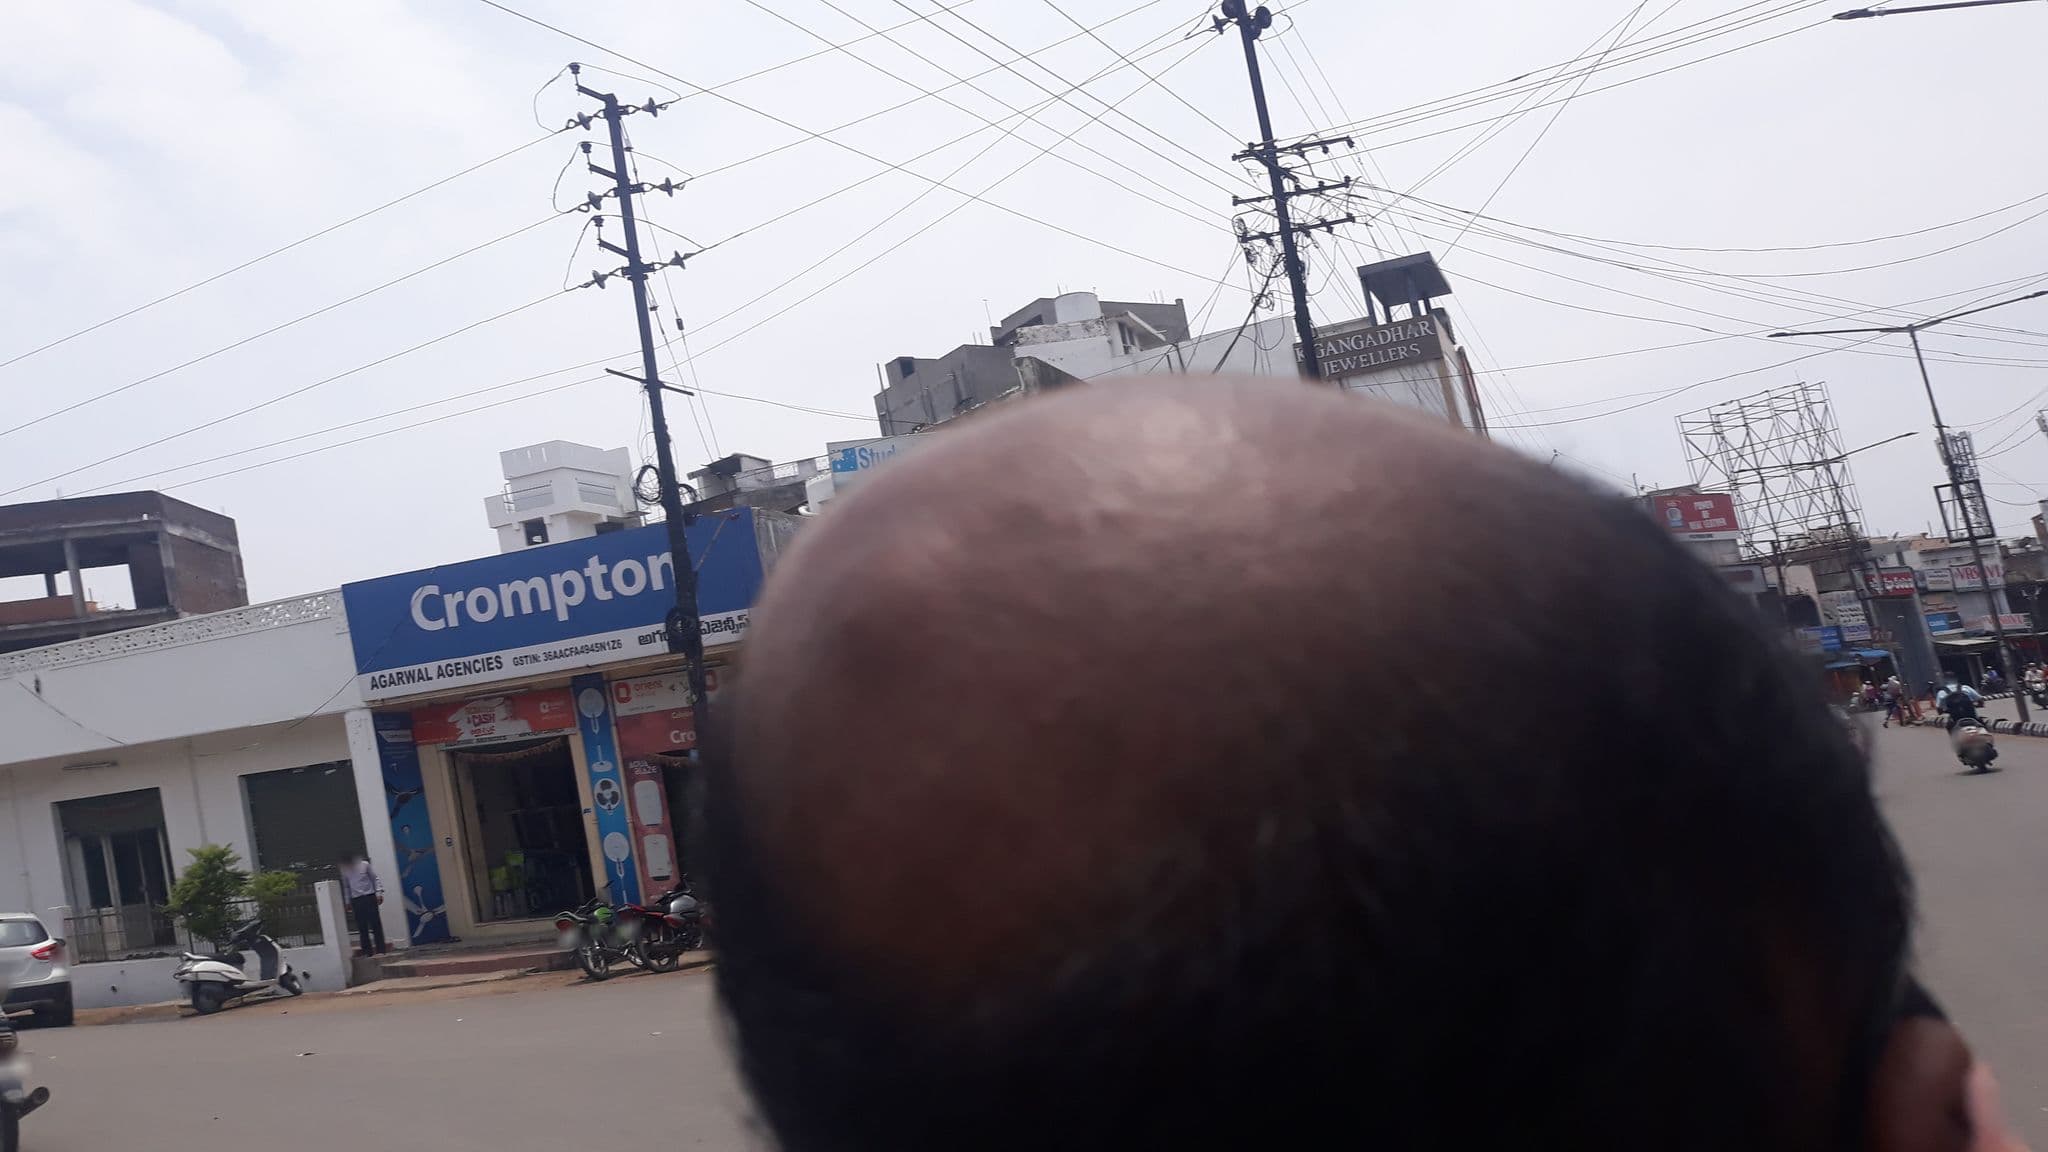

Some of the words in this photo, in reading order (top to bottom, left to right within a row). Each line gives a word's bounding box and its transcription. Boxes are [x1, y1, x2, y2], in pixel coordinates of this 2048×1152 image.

[1313, 320, 1435, 358] GANGADHAR
[1323, 343, 1421, 378] JEWELLERS
[411, 552, 675, 631] Crompton
[370, 668, 433, 691] AGARWAL
[437, 655, 503, 680] AGENCIES
[512, 654, 541, 666] GSTIN:
[670, 730, 697, 744] Cro
